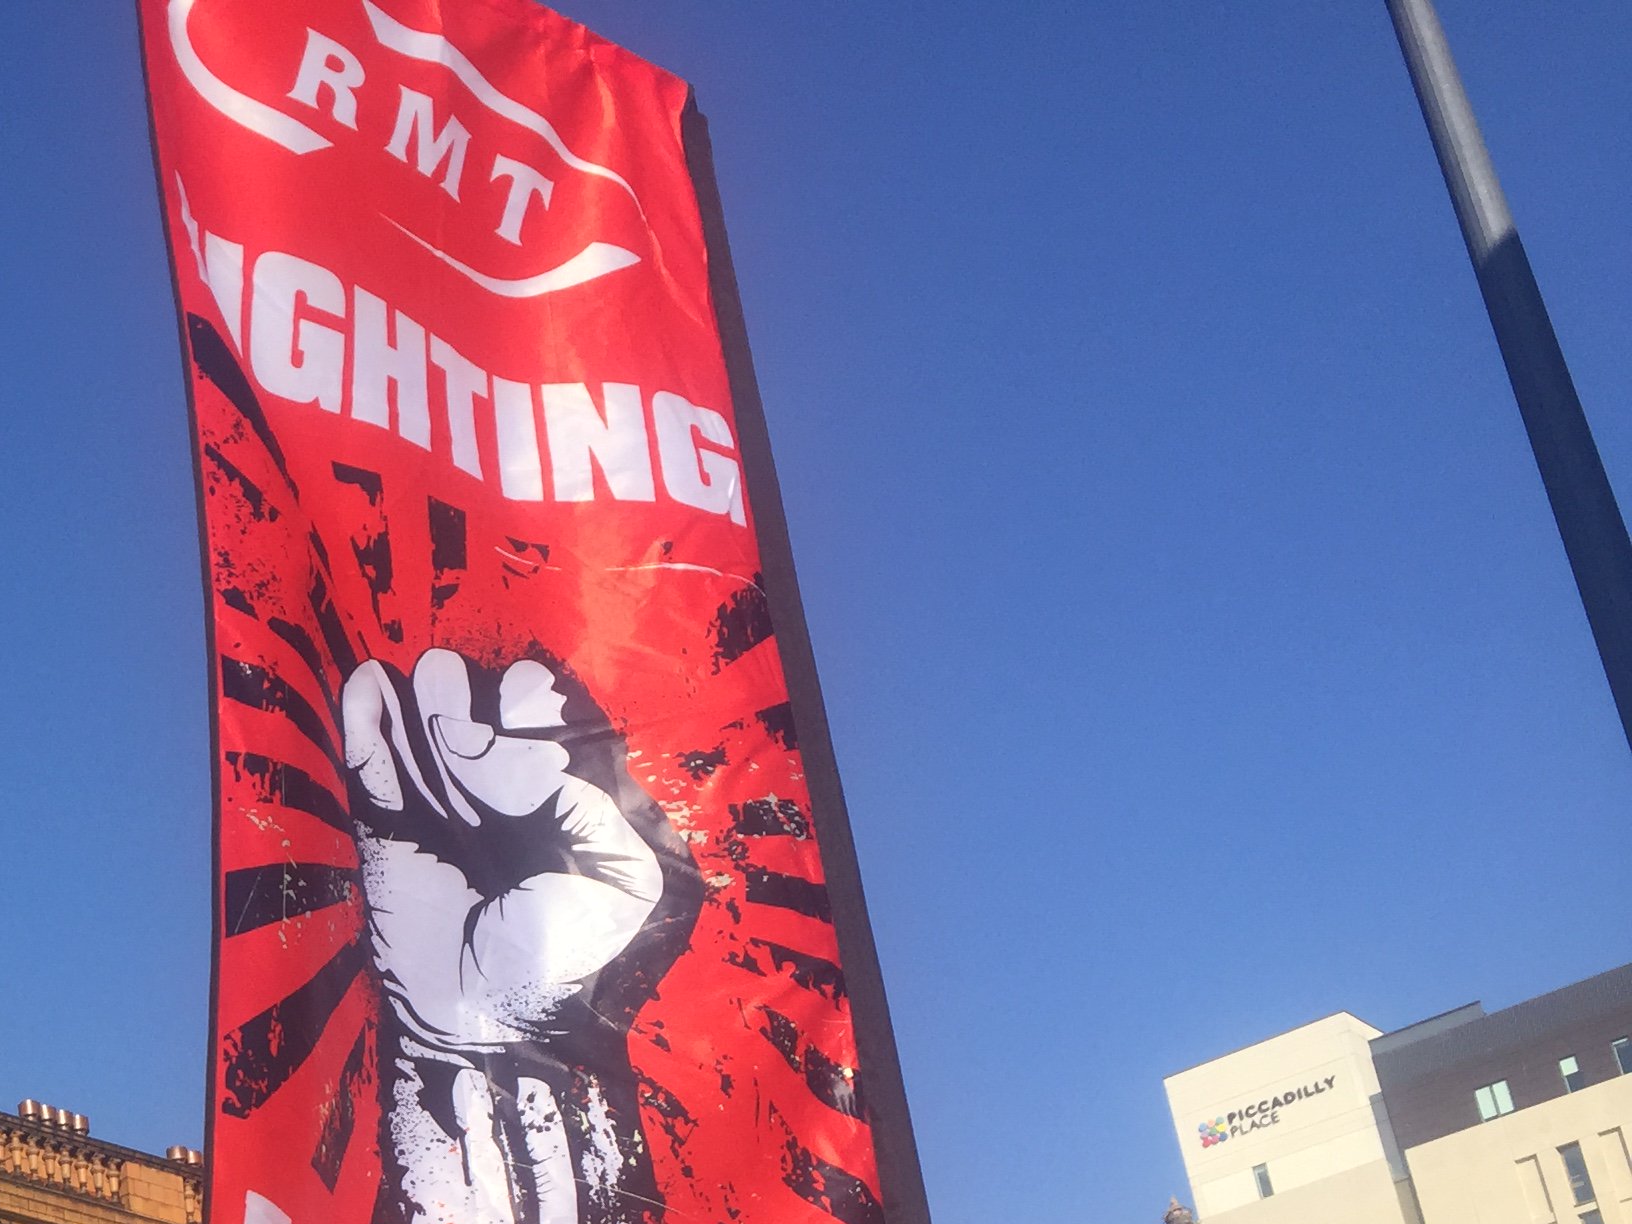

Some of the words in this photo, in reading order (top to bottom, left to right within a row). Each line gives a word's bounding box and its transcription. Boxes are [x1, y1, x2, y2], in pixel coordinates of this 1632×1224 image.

[286, 26, 554, 247] RMT
[175, 169, 747, 528] IGHTING
[1227, 1075, 1335, 1125] PICCADILLY
[1230, 1111, 1280, 1138] PLACE
